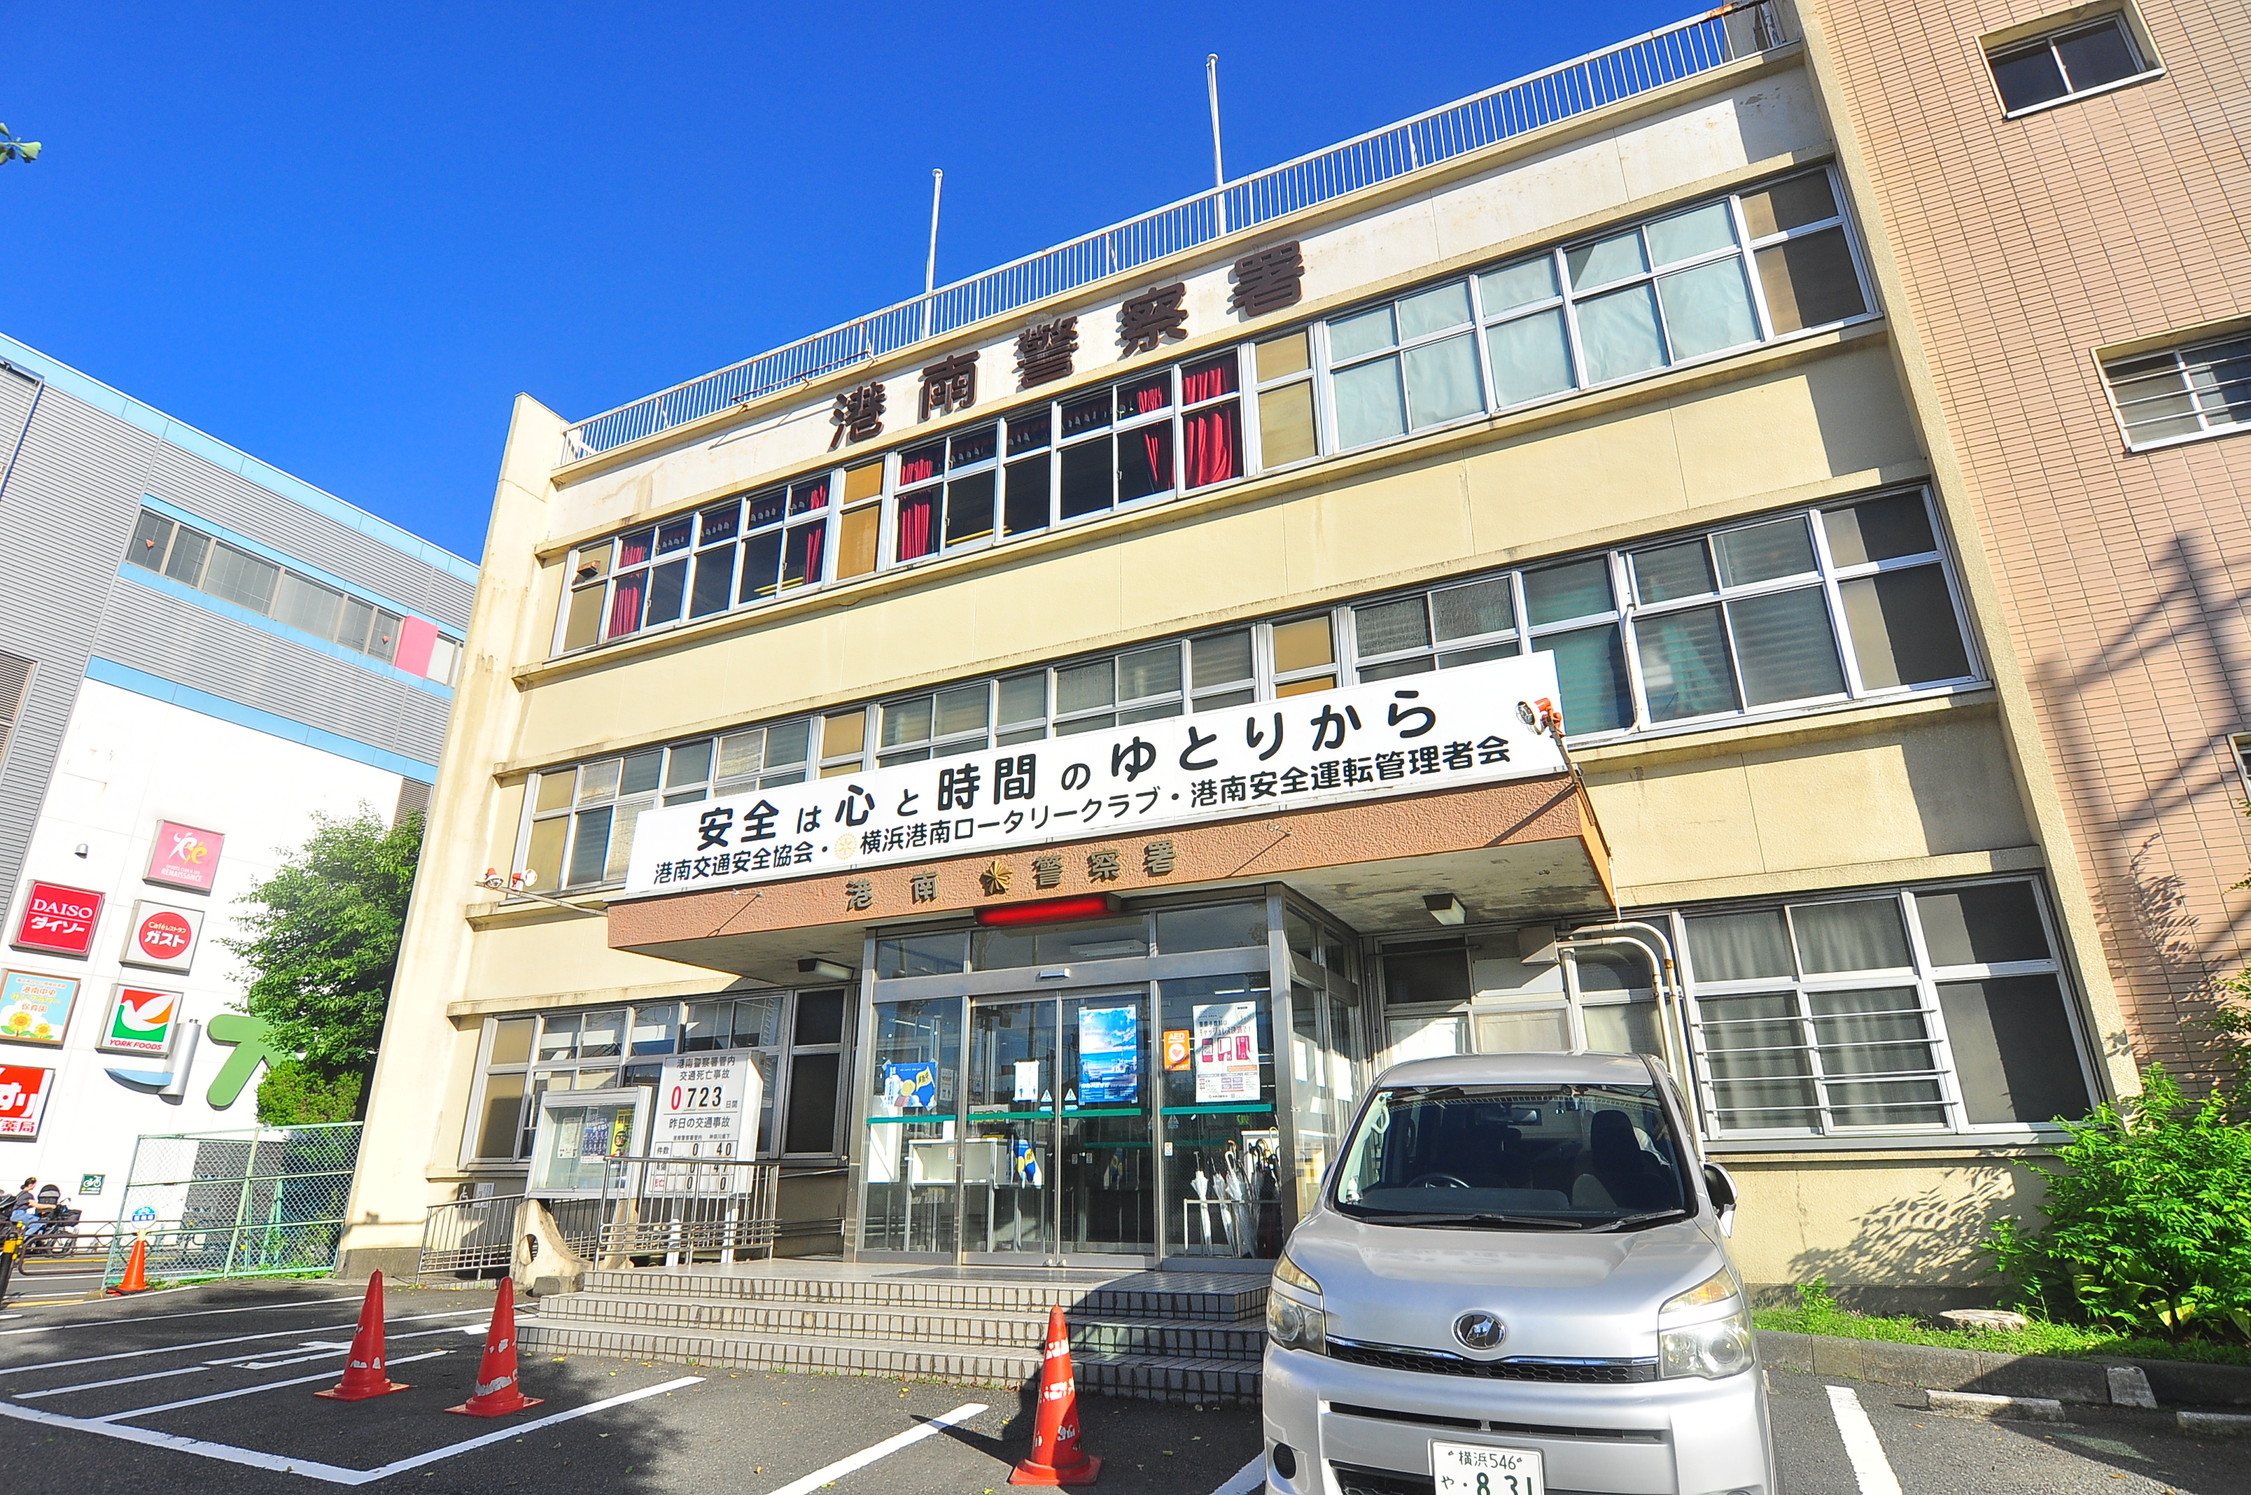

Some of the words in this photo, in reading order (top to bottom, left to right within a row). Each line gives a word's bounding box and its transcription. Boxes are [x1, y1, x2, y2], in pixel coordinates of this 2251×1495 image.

[828, 240, 1305, 452] 港南警察署
[32, 898, 93, 918] DAISO
[31, 916, 85, 934] ダイソー
[144, 930, 185, 947] ガスト
[1168, 1033, 1185, 1041] AED
[109, 1039, 133, 1047] YORK
[133, 1042, 163, 1050] FOODS
[679, 1069, 730, 1081] 交通死亡事故
[0, 1119, 36, 1133] 薬局
[669, 1117, 731, 1129] 昨日の交通事故
[692, 1143, 699, 1156] 0
[716, 1143, 732, 1156] 40
